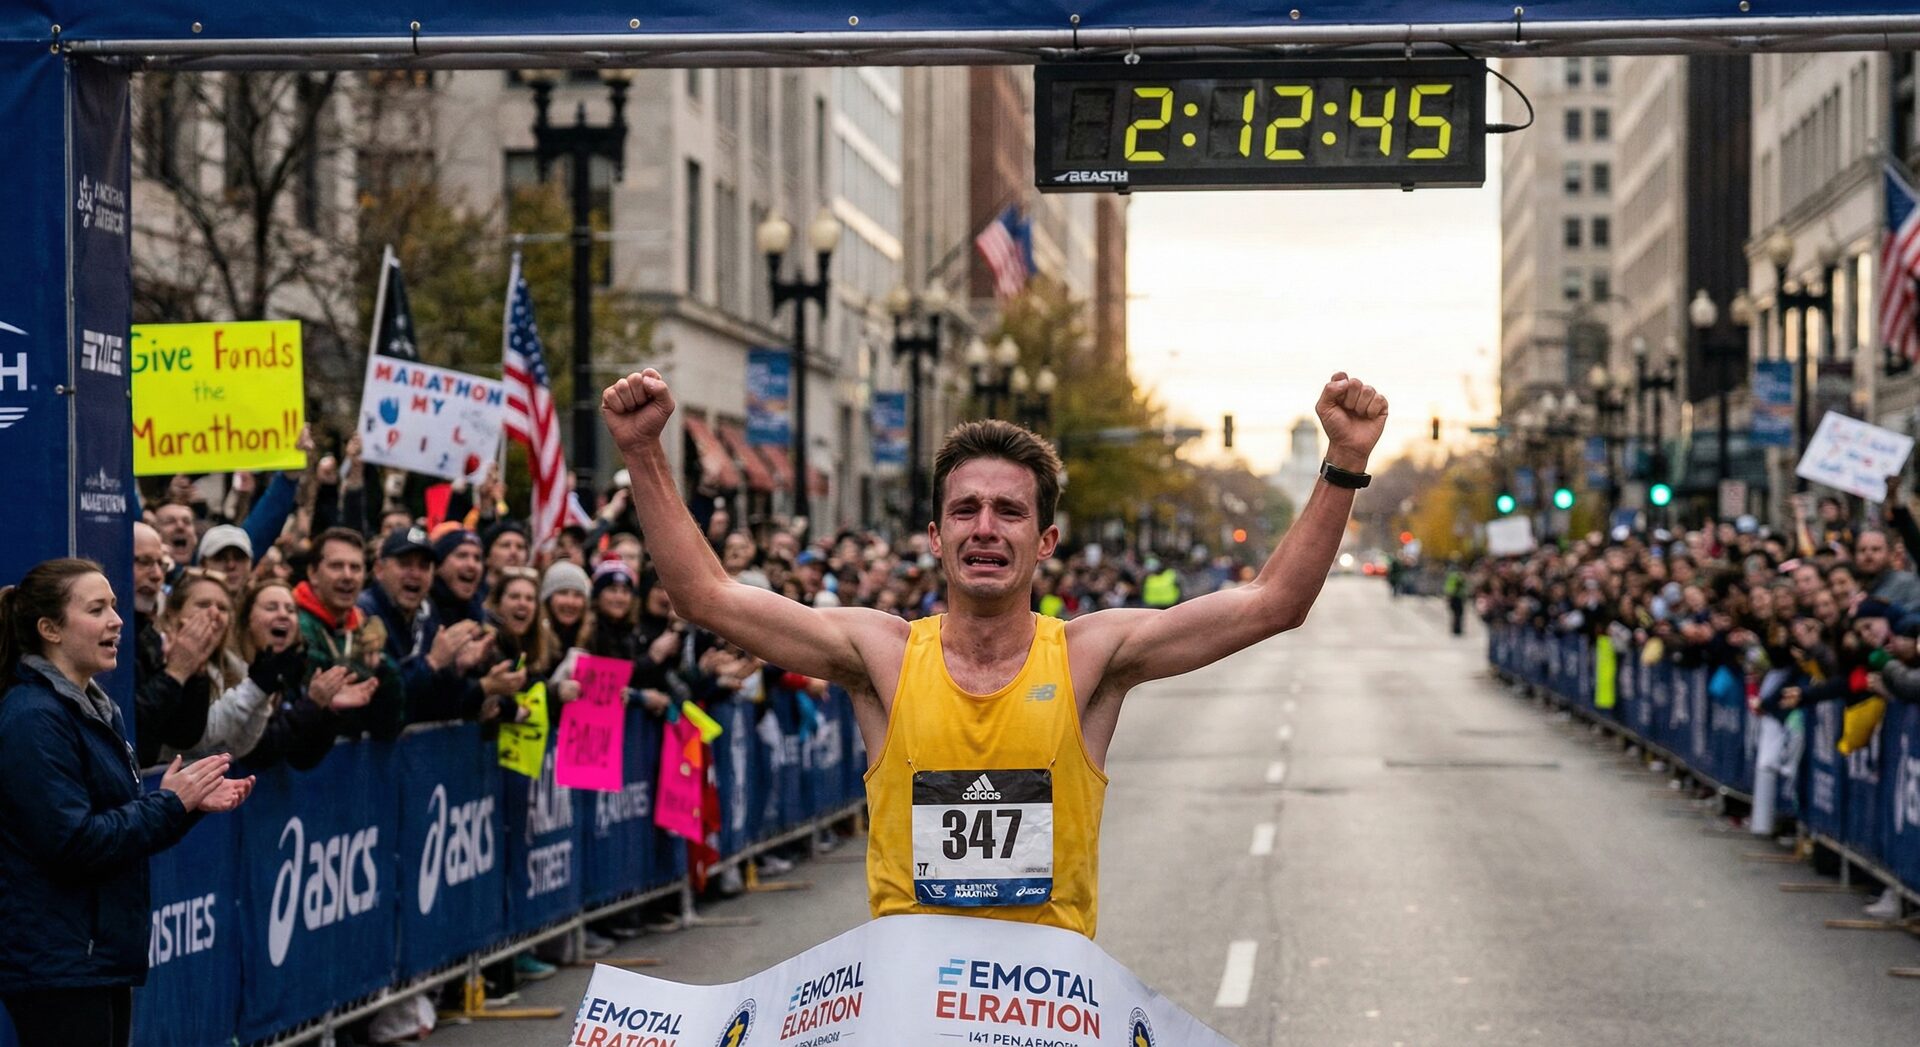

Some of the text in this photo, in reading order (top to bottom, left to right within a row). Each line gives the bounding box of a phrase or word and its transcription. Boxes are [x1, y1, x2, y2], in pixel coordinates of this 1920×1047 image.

[1124, 84, 1453, 162] 2:12:45
[131, 332, 193, 373] Give
[193, 381, 225, 402] the
[132, 410, 298, 458] Marathon!!
[962, 790, 1001, 801] adidas
[942, 809, 1022, 860] 347
[799, 962, 864, 1008] EMOTAL
[969, 960, 1099, 1008] EMOTAL
[587, 997, 682, 1035] EMOTAL
[780, 992, 863, 1041] ELRATION
[936, 990, 1100, 1040] ELRATION
